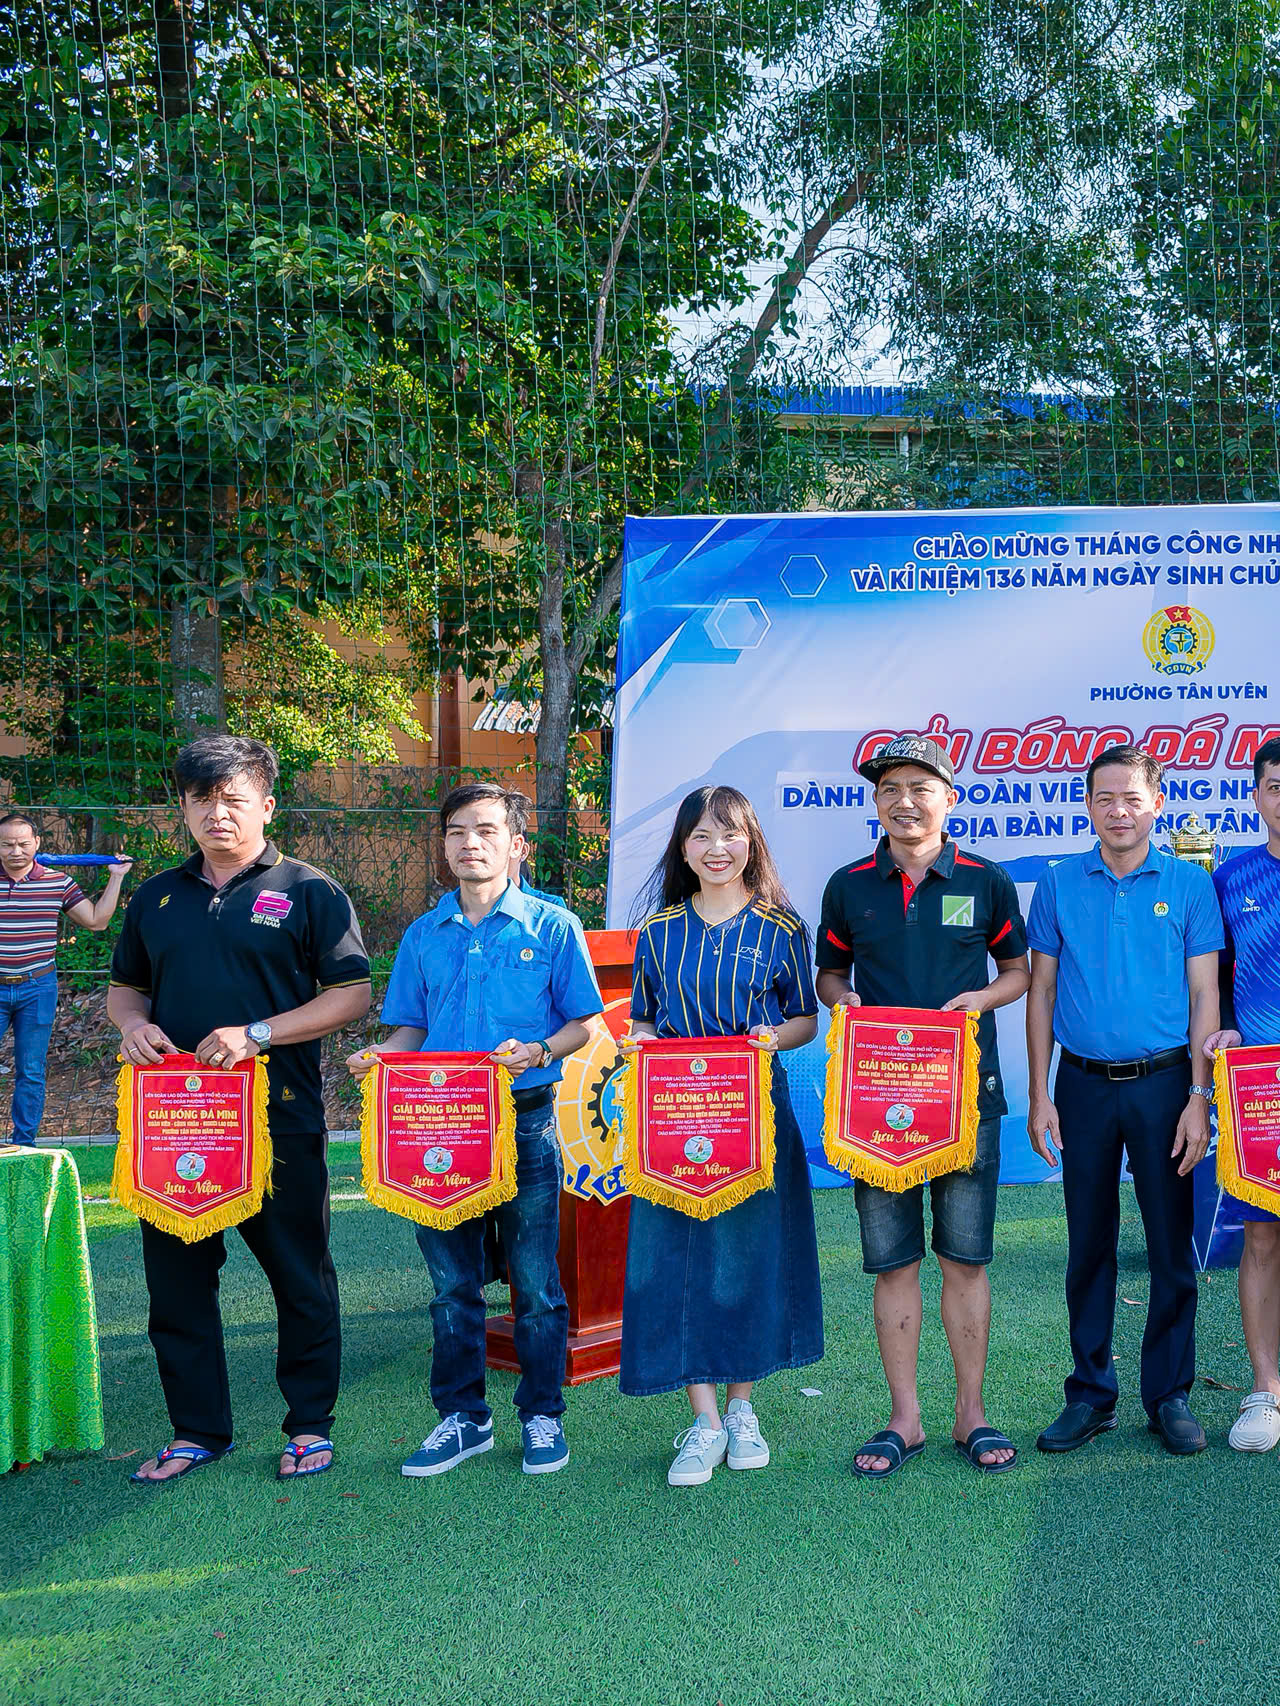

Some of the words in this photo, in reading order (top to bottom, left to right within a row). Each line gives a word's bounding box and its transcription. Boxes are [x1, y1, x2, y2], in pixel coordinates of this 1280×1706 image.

[914, 533, 988, 558] CHÀO
[994, 532, 1070, 557] MỪNG
[1075, 531, 1161, 555] THÁNG
[1167, 530, 1243, 554] CÔNG
[852, 565, 886, 590] VÀ
[891, 563, 915, 589] KỈ
[920, 566, 981, 595] NIỆM
[986, 568, 1026, 588] 136
[1032, 562, 1086, 587] NĂM
[1093, 561, 1162, 586] NGÀY
[1166, 565, 1223, 585] SINH
[1230, 558, 1277, 585] CHỦ
[1090, 683, 1173, 701] PHƯỜNG
[1177, 682, 1213, 700] TÂN
[1217, 682, 1268, 699] UYÊN
[783, 782, 865, 808] DÀNH
[1039, 777, 1085, 803] VIÊ
[947, 816, 999, 844] ĐỊA
[1005, 810, 1064, 838] BÀN
[1205, 807, 1260, 833] TÂN
[858, 1058, 879, 1070] GIẢI
[881, 1060, 909, 1072] BÓNG
[911, 1061, 924, 1073] ĐÁ
[926, 1063, 948, 1074] MINI
[653, 1091, 673, 1103] GIẢI
[675, 1091, 704, 1103] BÓNG
[706, 1090, 720, 1102] ĐÁ
[722, 1092, 744, 1102] MINI
[148, 1108, 168, 1119] GIẢI
[170, 1108, 198, 1119] BÓNG
[200, 1107, 215, 1118] ĐÁ
[216, 1110, 237, 1119] MINI
[392, 1103, 413, 1114] GIẢI
[414, 1104, 443, 1114] BÓNG
[445, 1103, 460, 1114] ĐÁ
[462, 1105, 484, 1114] MINI
[1244, 1100, 1263, 1111] GIẢI
